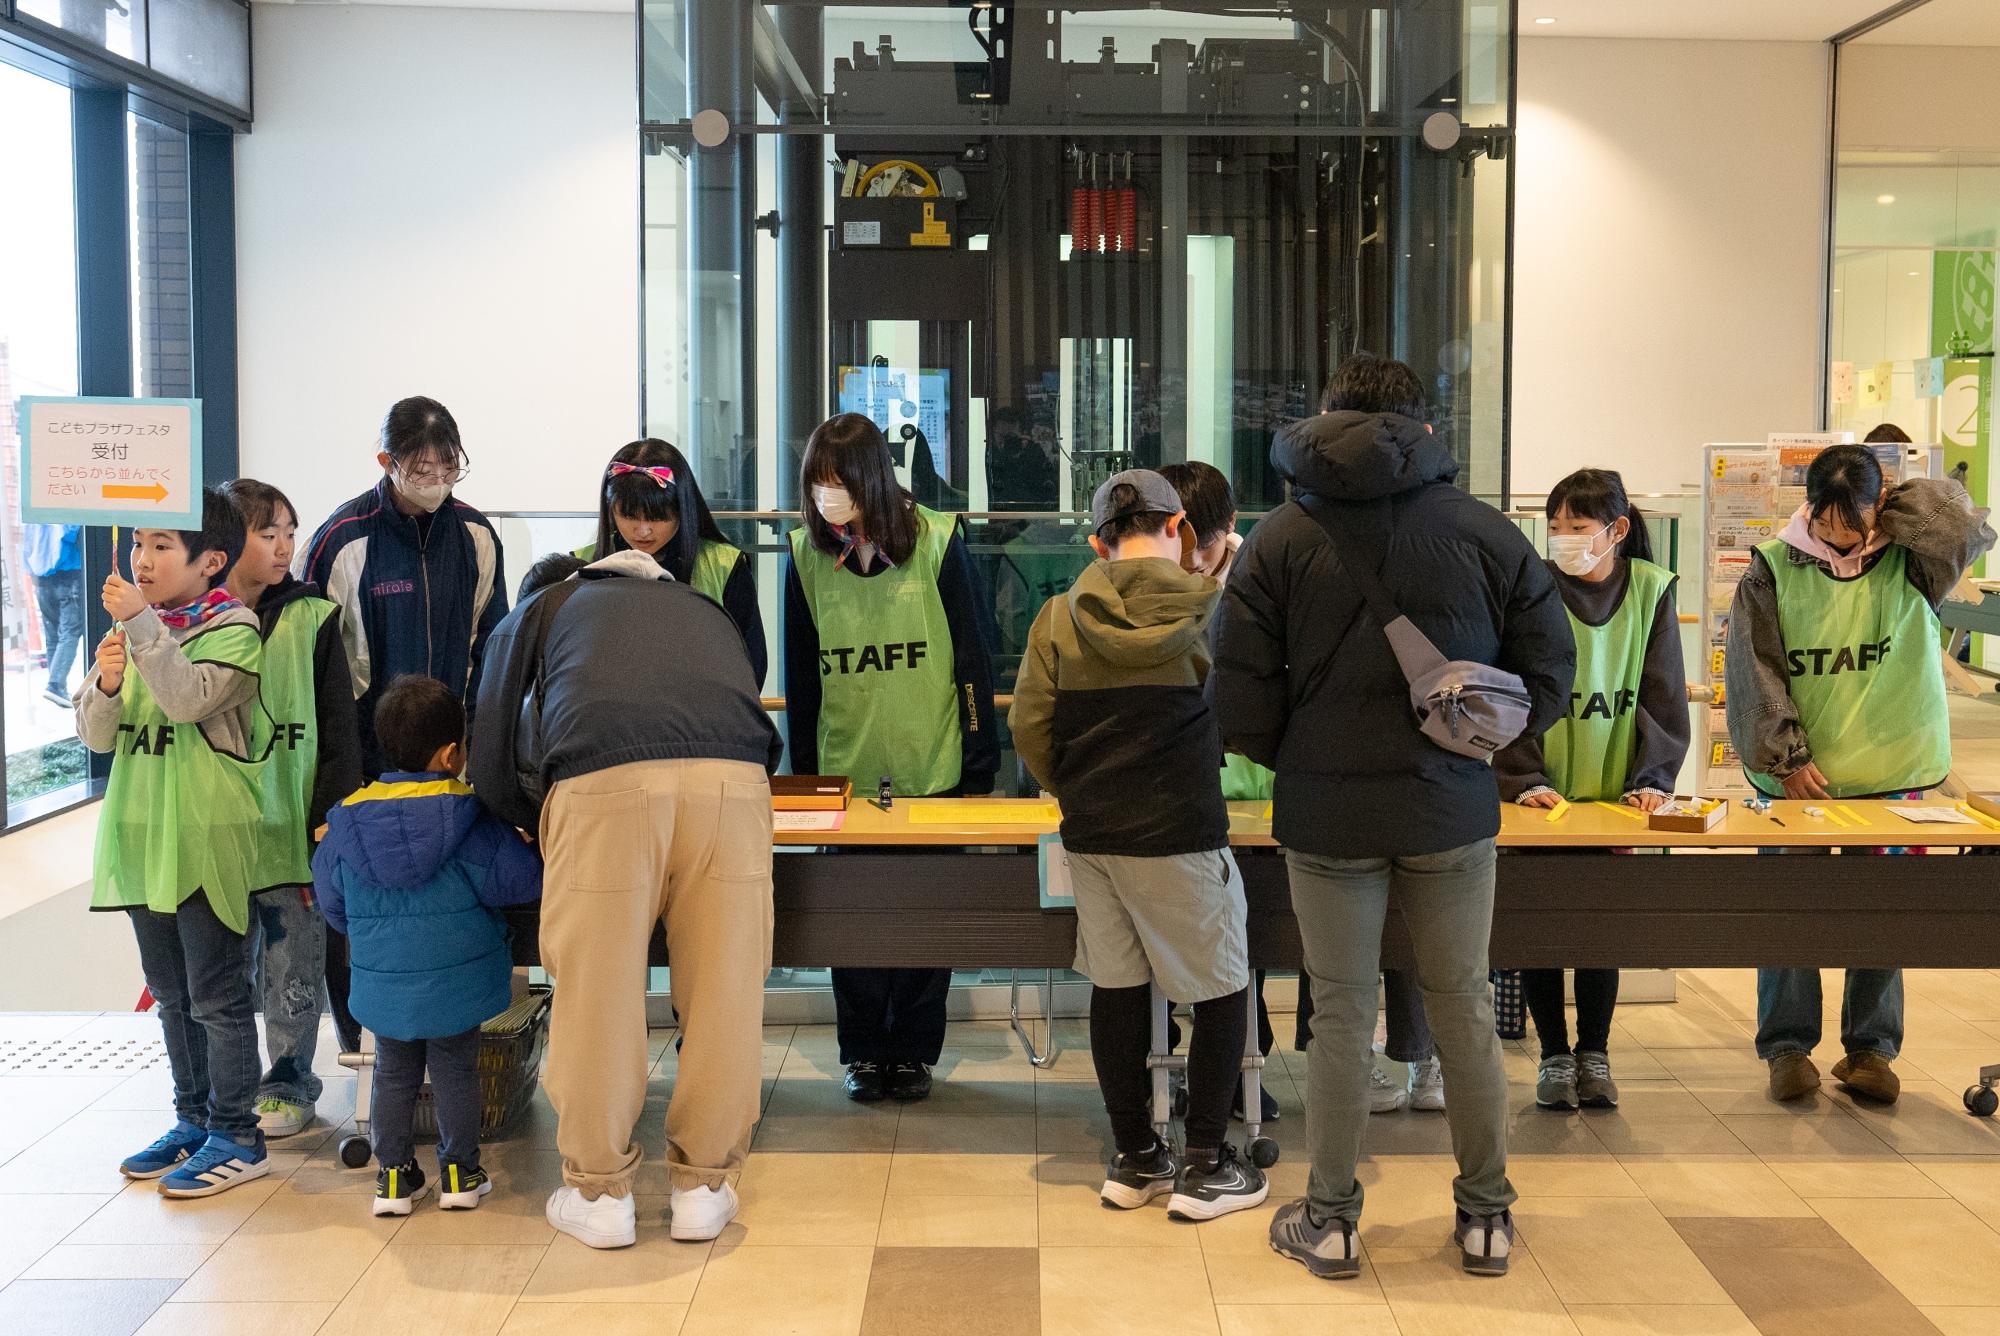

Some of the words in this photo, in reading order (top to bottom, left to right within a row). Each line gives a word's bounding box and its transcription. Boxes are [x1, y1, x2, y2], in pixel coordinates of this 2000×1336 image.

[48, 422, 170, 436] こどもプラザフェスタ
[92, 443, 129, 460] 受付
[48, 467, 171, 480] こちらから並んでく
[48, 483, 86, 496] ださい
[819, 641, 927, 676] STAFF
[1788, 636, 1891, 677] STAFF
[965, 683, 978, 732] DESCENTE
